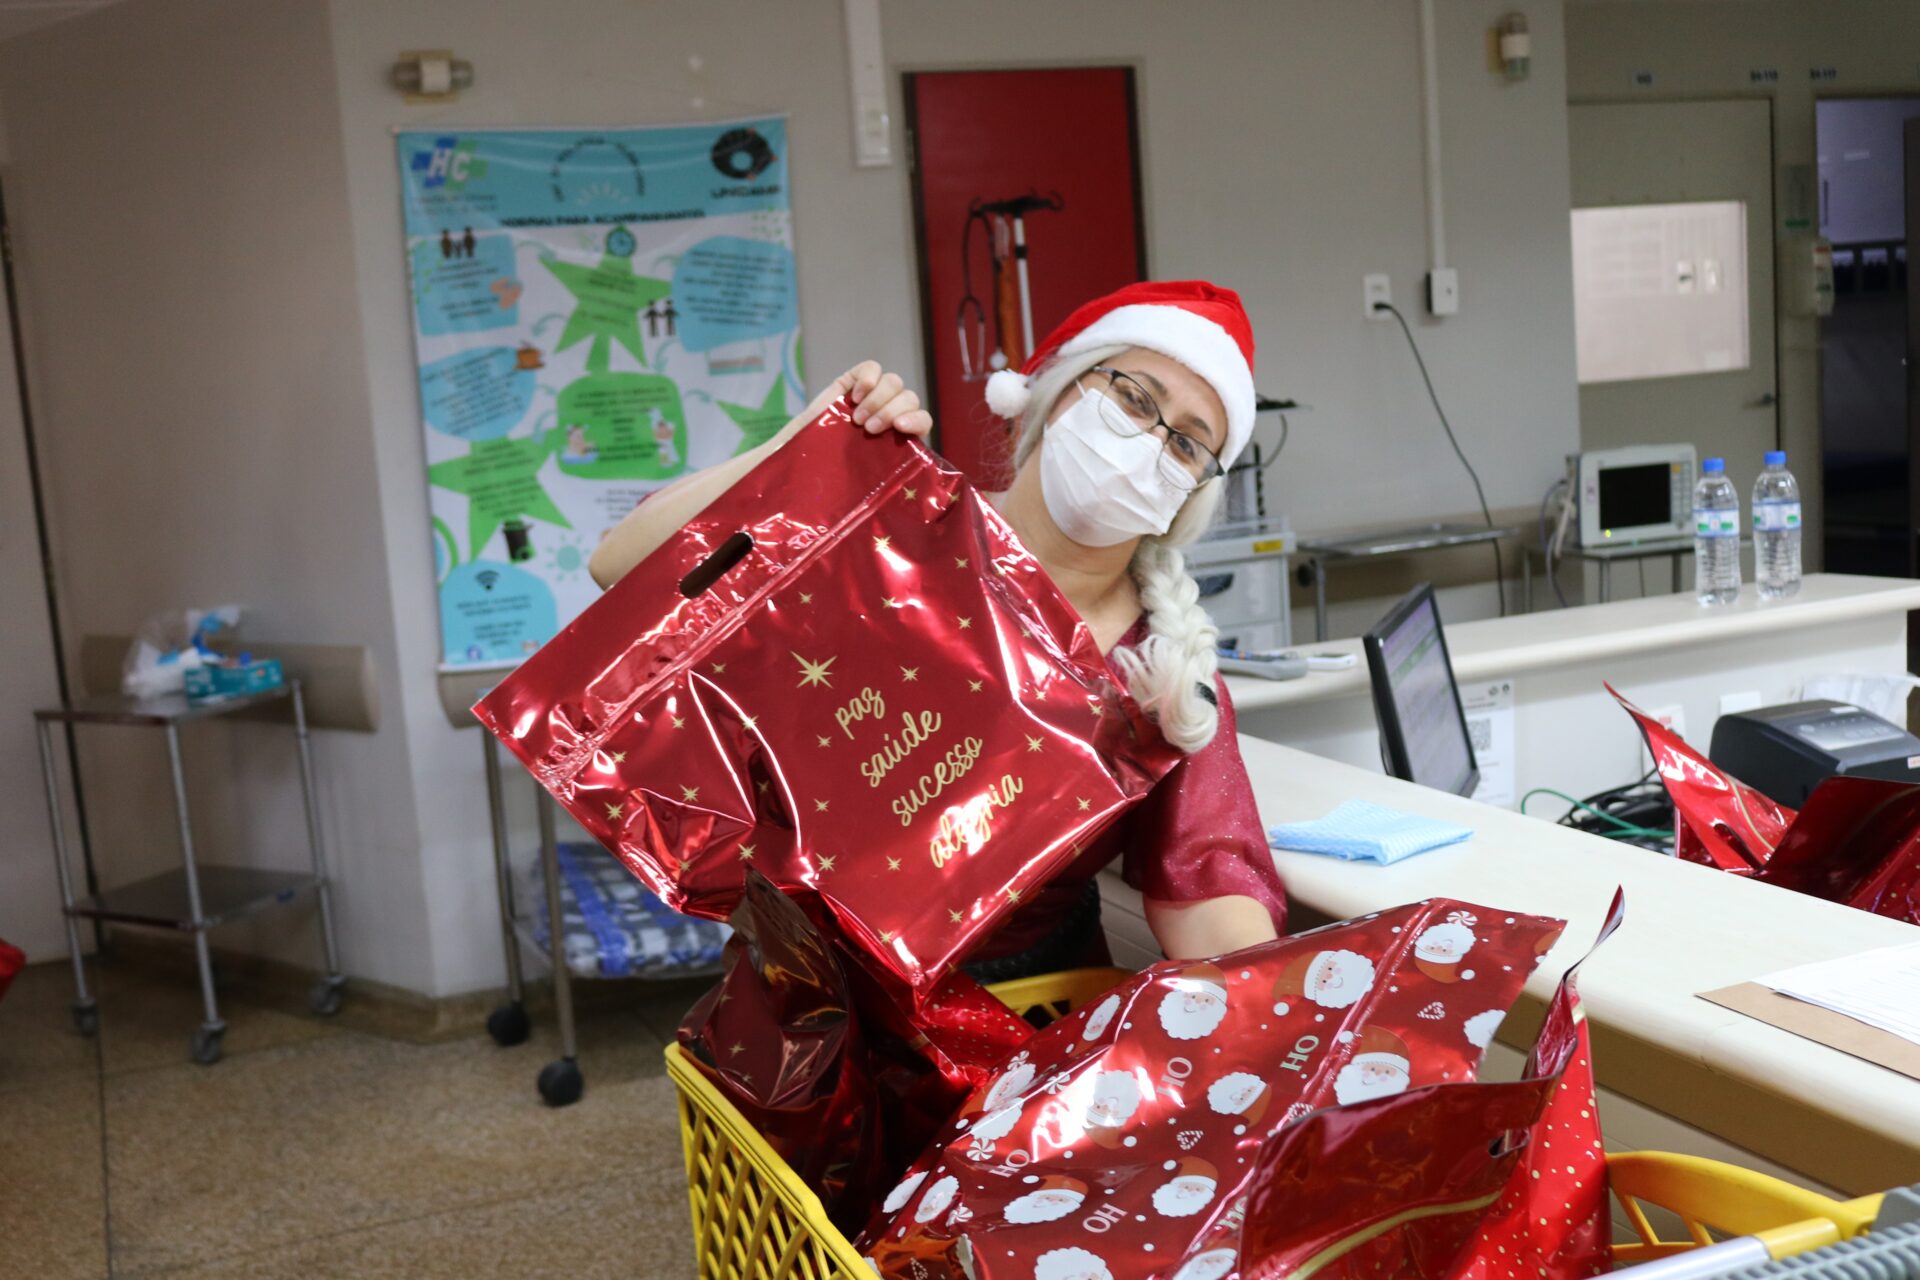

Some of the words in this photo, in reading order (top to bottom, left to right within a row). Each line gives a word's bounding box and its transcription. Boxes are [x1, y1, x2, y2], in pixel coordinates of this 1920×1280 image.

[427, 148, 471, 182] HC
[834, 687, 885, 740] paz
[892, 737, 983, 826] sucesso
[930, 774, 1023, 868] alegria
[1279, 1035, 1320, 1072] HO
[989, 1149, 1030, 1178] HO
